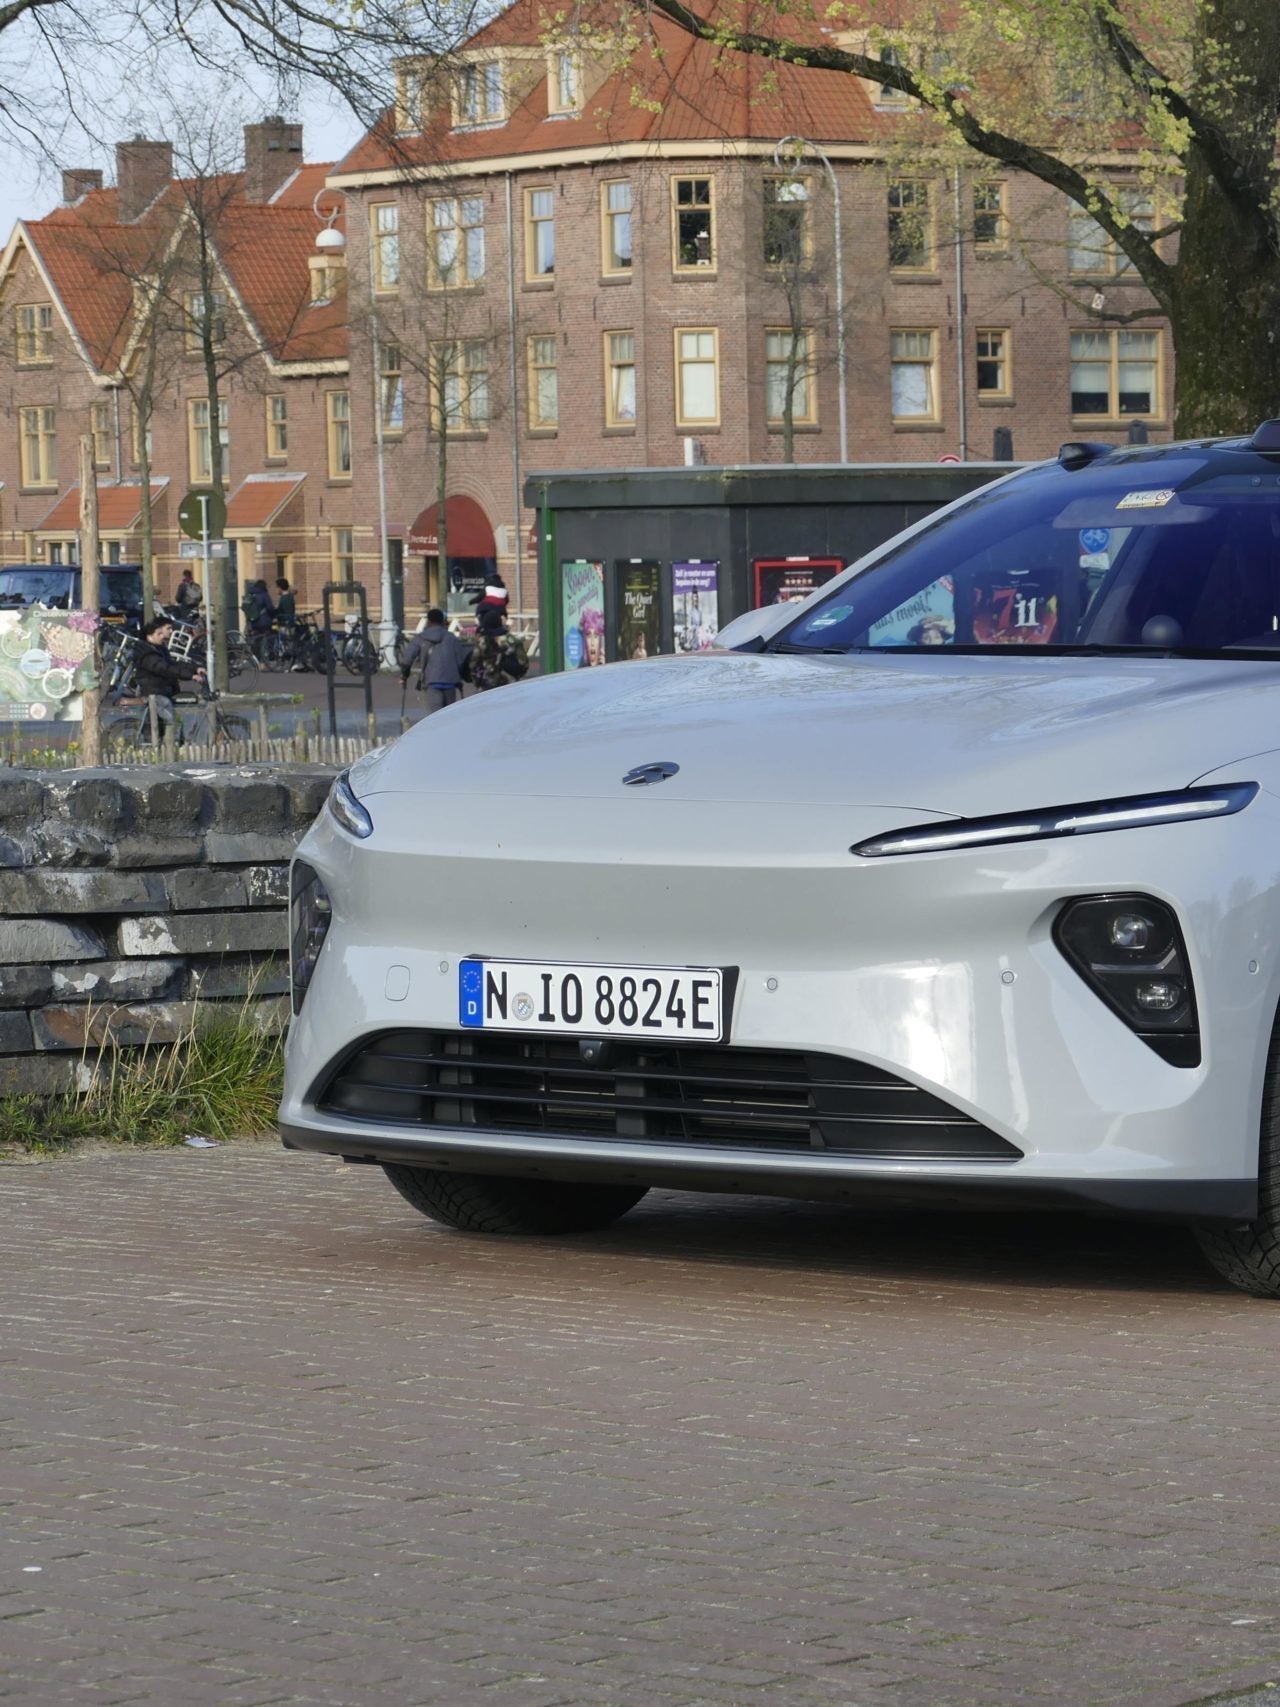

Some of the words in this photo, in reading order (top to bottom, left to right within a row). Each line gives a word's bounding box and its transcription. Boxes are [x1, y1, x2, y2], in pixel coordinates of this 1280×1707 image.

[624, 592, 636, 605] The
[636, 591, 653, 608] Quiet
[632, 604, 646, 618] Girl
[468, 1001, 477, 1015] D
[487, 971, 507, 1019] N
[538, 973, 582, 1024] IO
[595, 975, 714, 1030] 8824E
